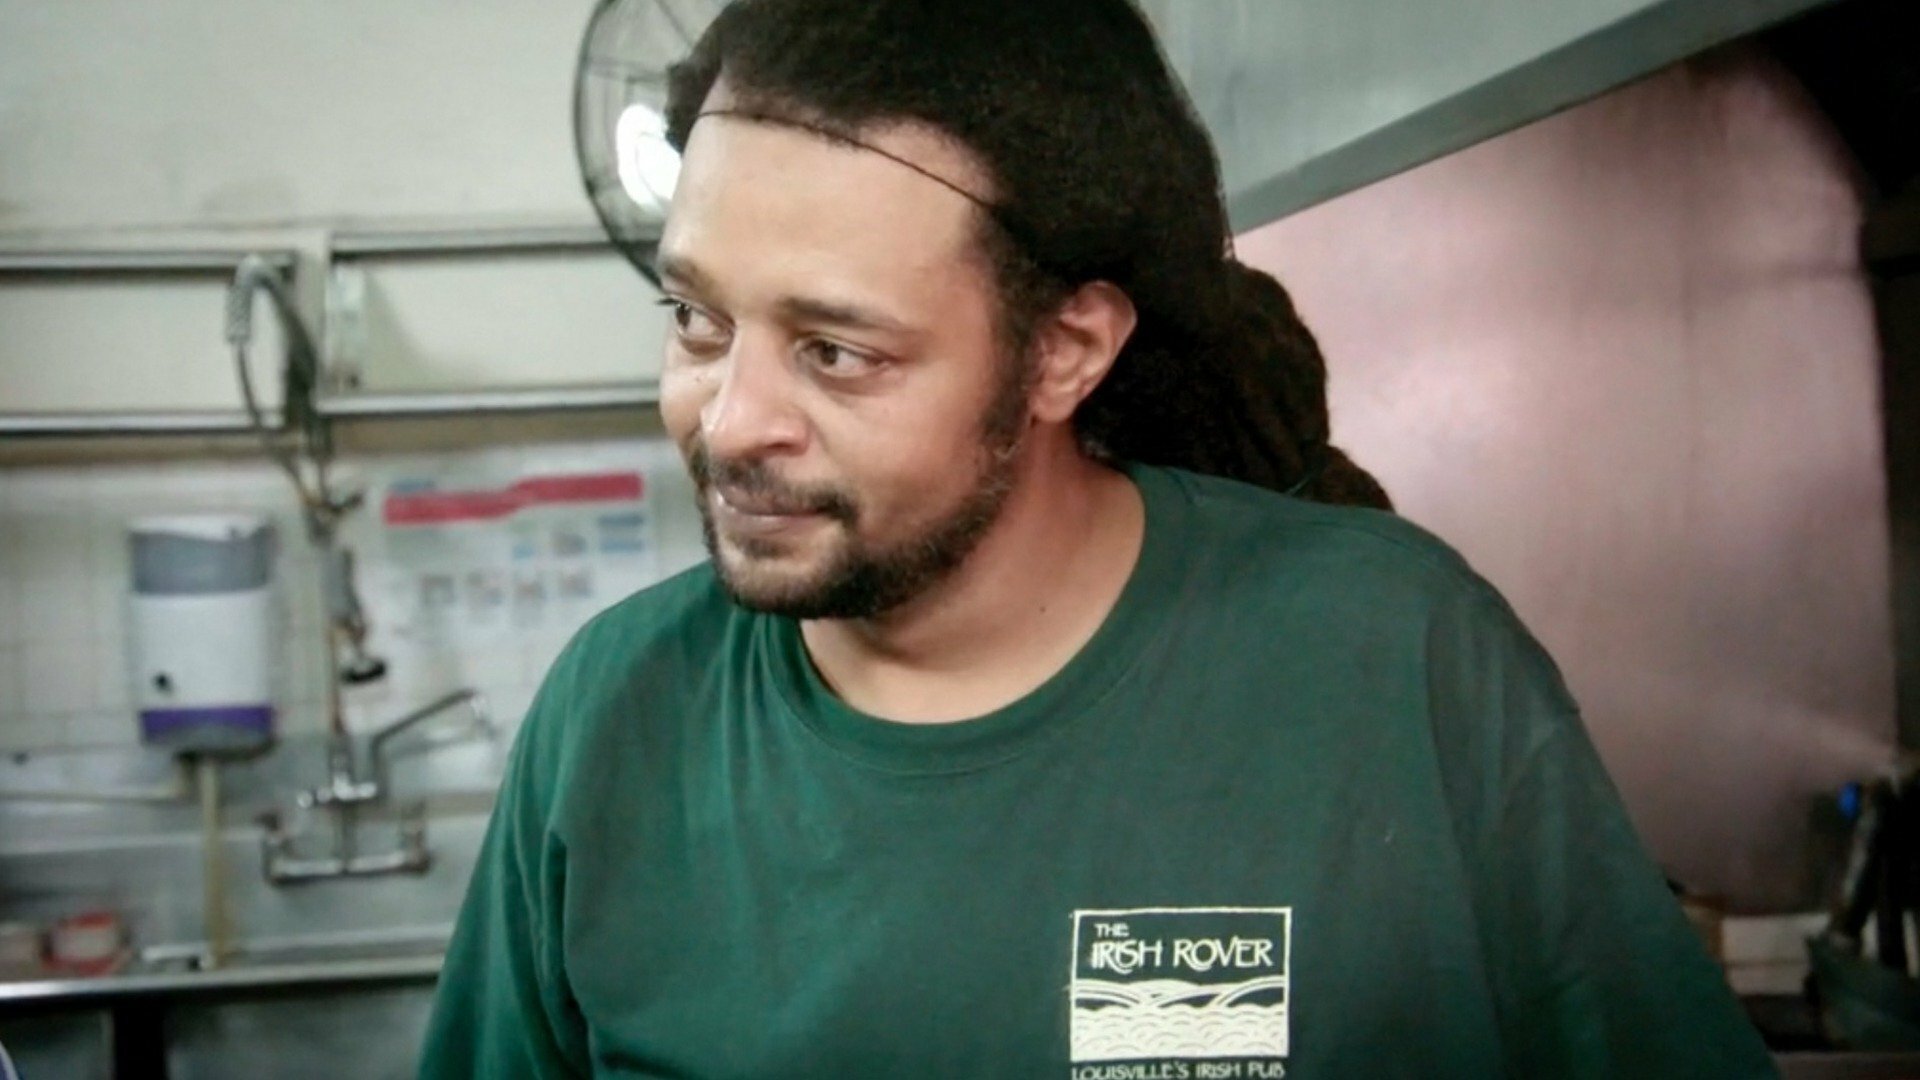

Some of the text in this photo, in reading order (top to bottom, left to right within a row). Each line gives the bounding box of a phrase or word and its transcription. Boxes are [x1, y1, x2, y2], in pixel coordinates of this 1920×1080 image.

[1094, 923, 1130, 937] THE
[1091, 936, 1273, 974] IRISH ROVER
[1072, 1062, 1285, 1080] LOUISVILLE'S IRISH PUB
